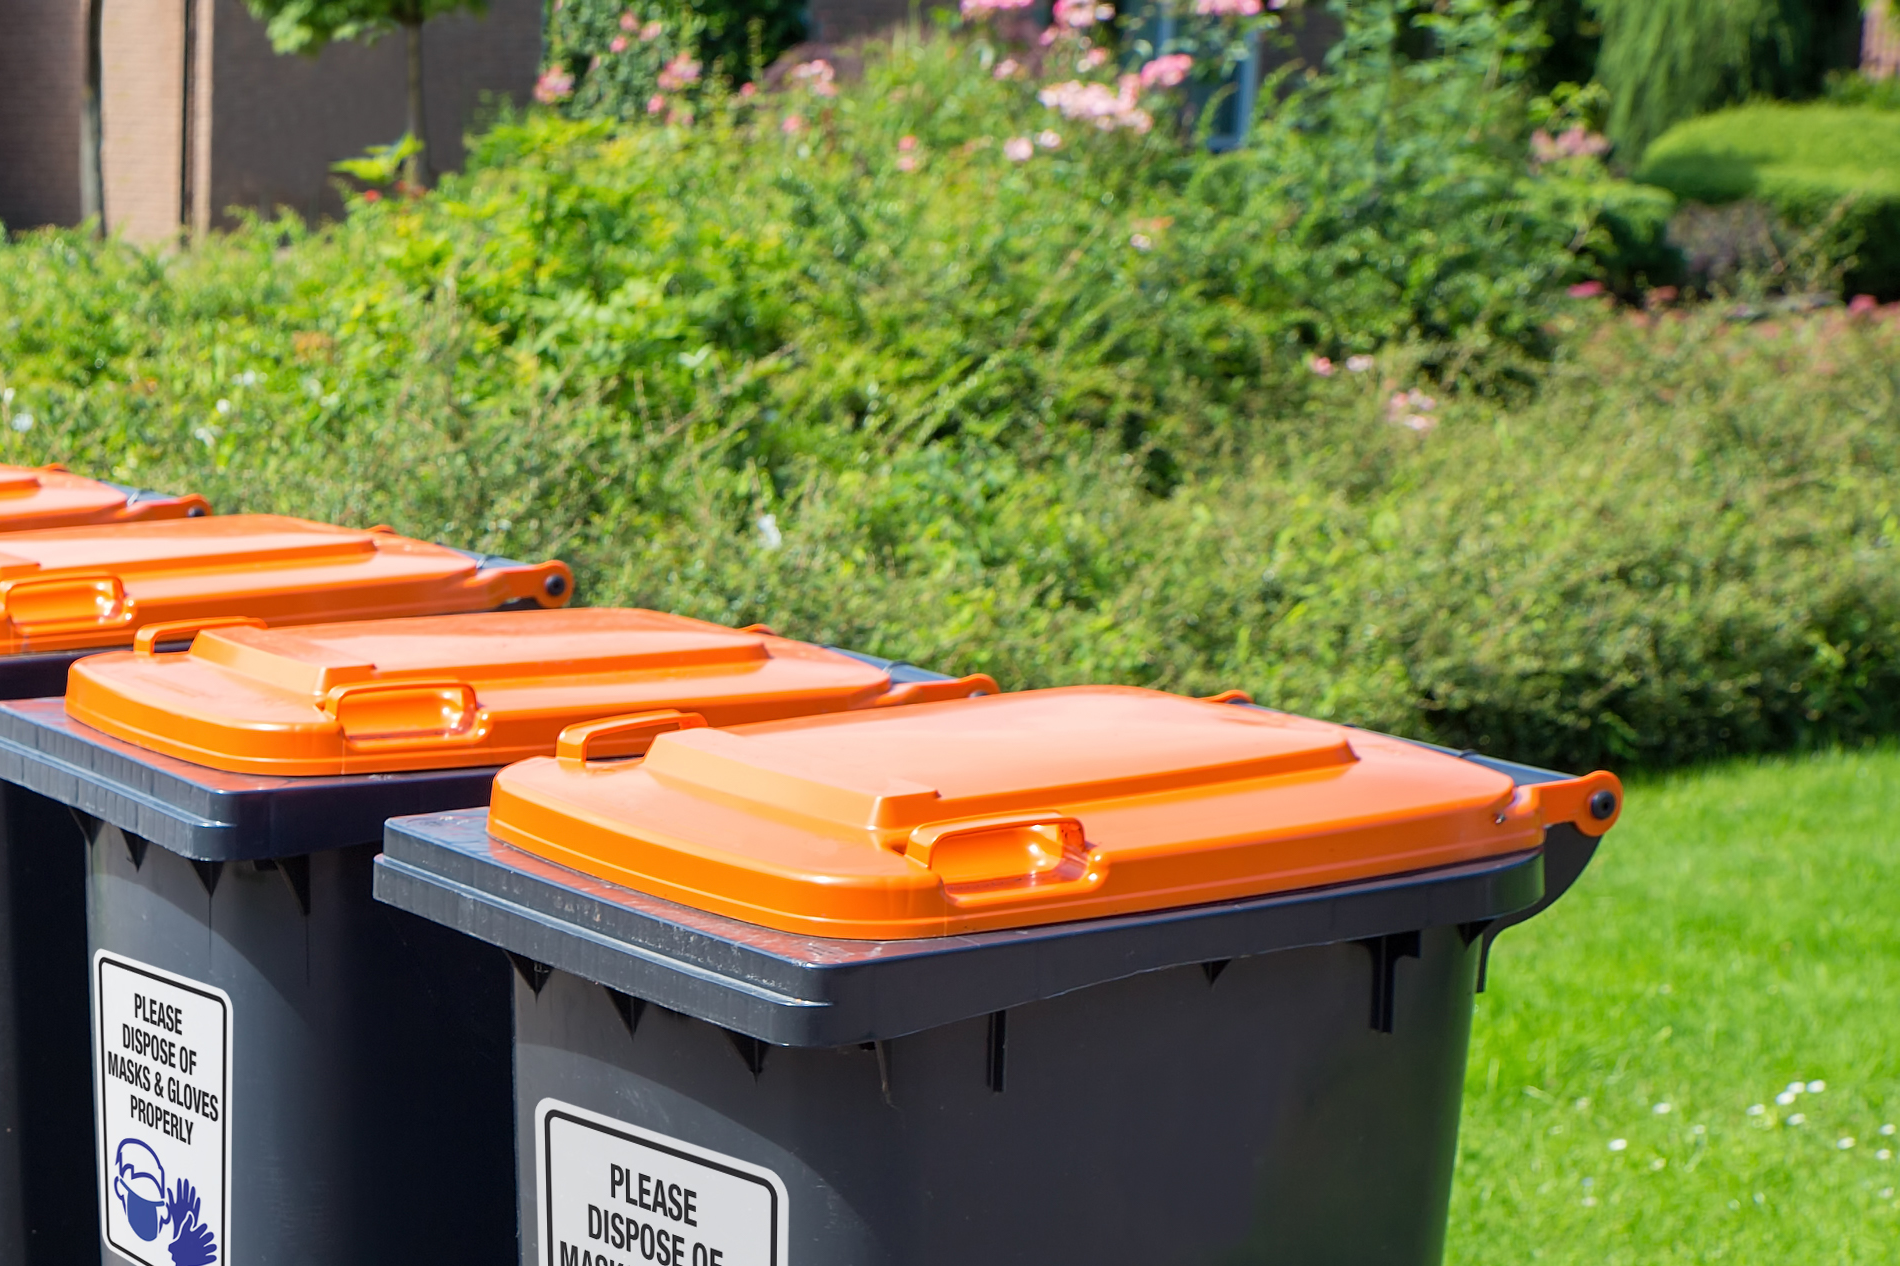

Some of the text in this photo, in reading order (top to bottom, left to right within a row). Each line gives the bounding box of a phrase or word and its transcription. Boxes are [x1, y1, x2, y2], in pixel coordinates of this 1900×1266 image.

[134, 992, 183, 1036] PLEASE
[122, 1023, 197, 1076] DISPOSE OF
[108, 1051, 219, 1122] MASKS & GLOVES
[130, 1094, 194, 1146] PROPERLY
[610, 1162, 698, 1228] PLEASE
